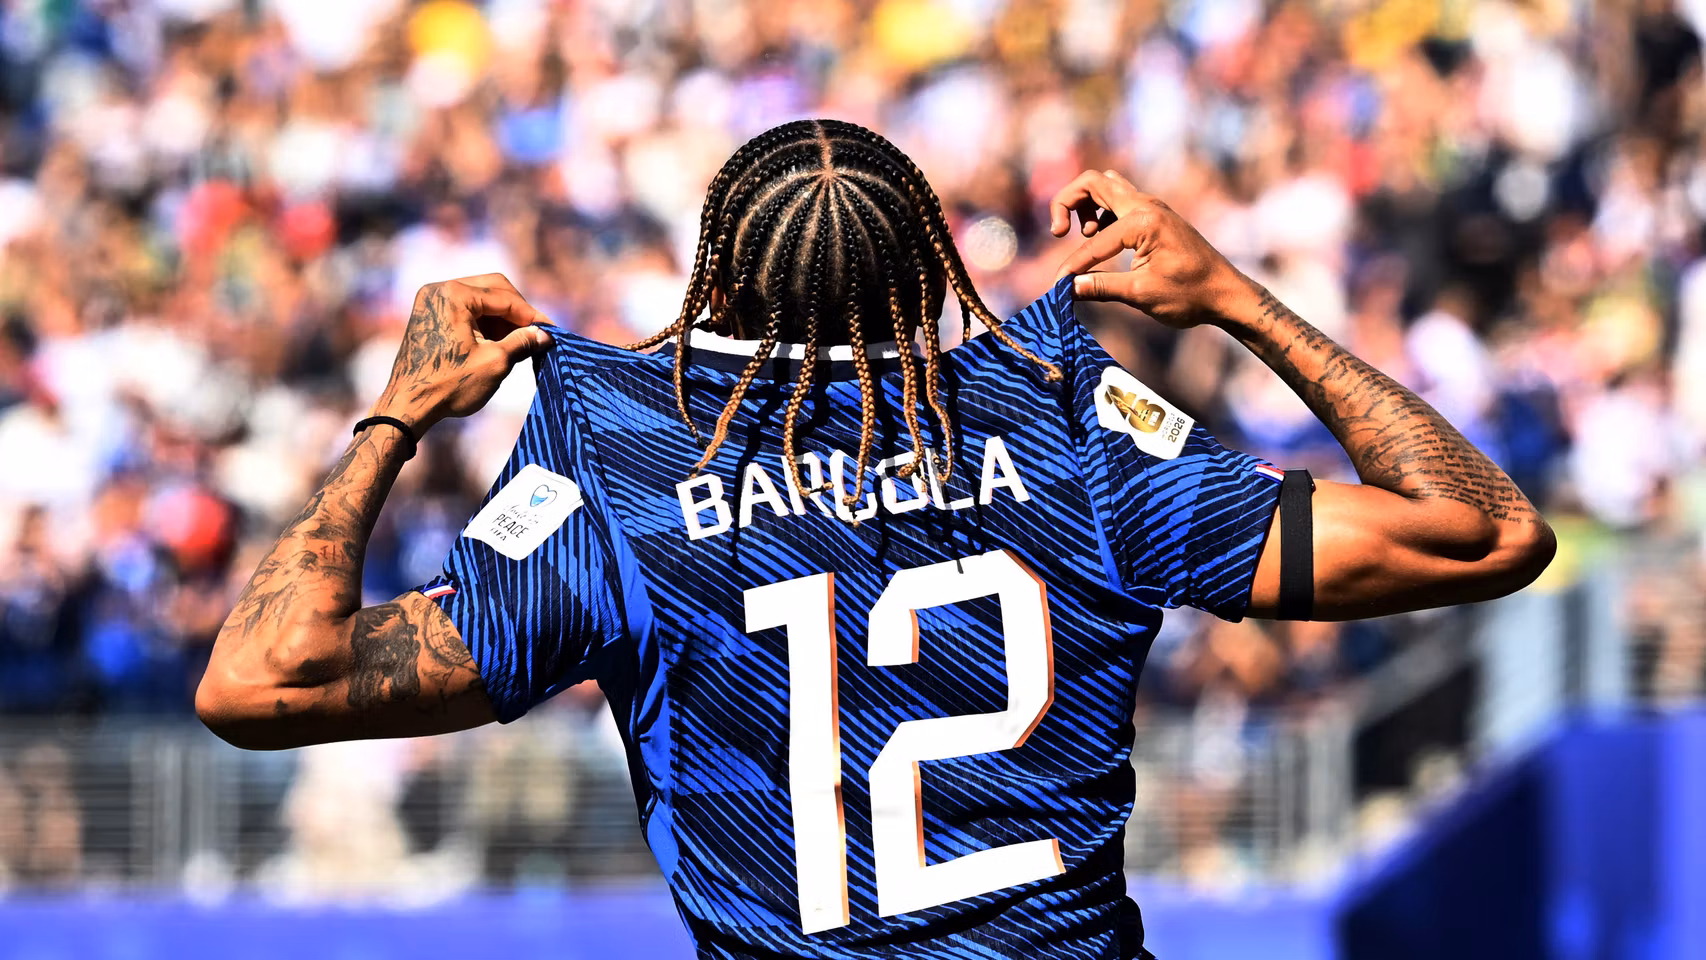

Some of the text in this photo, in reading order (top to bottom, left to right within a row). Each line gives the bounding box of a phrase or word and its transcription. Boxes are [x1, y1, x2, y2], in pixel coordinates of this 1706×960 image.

[1168, 416, 1186, 443] 2026
[675, 436, 1030, 541] BARCOLA
[492, 513, 530, 539] PEACE
[743, 549, 1066, 935] 12
